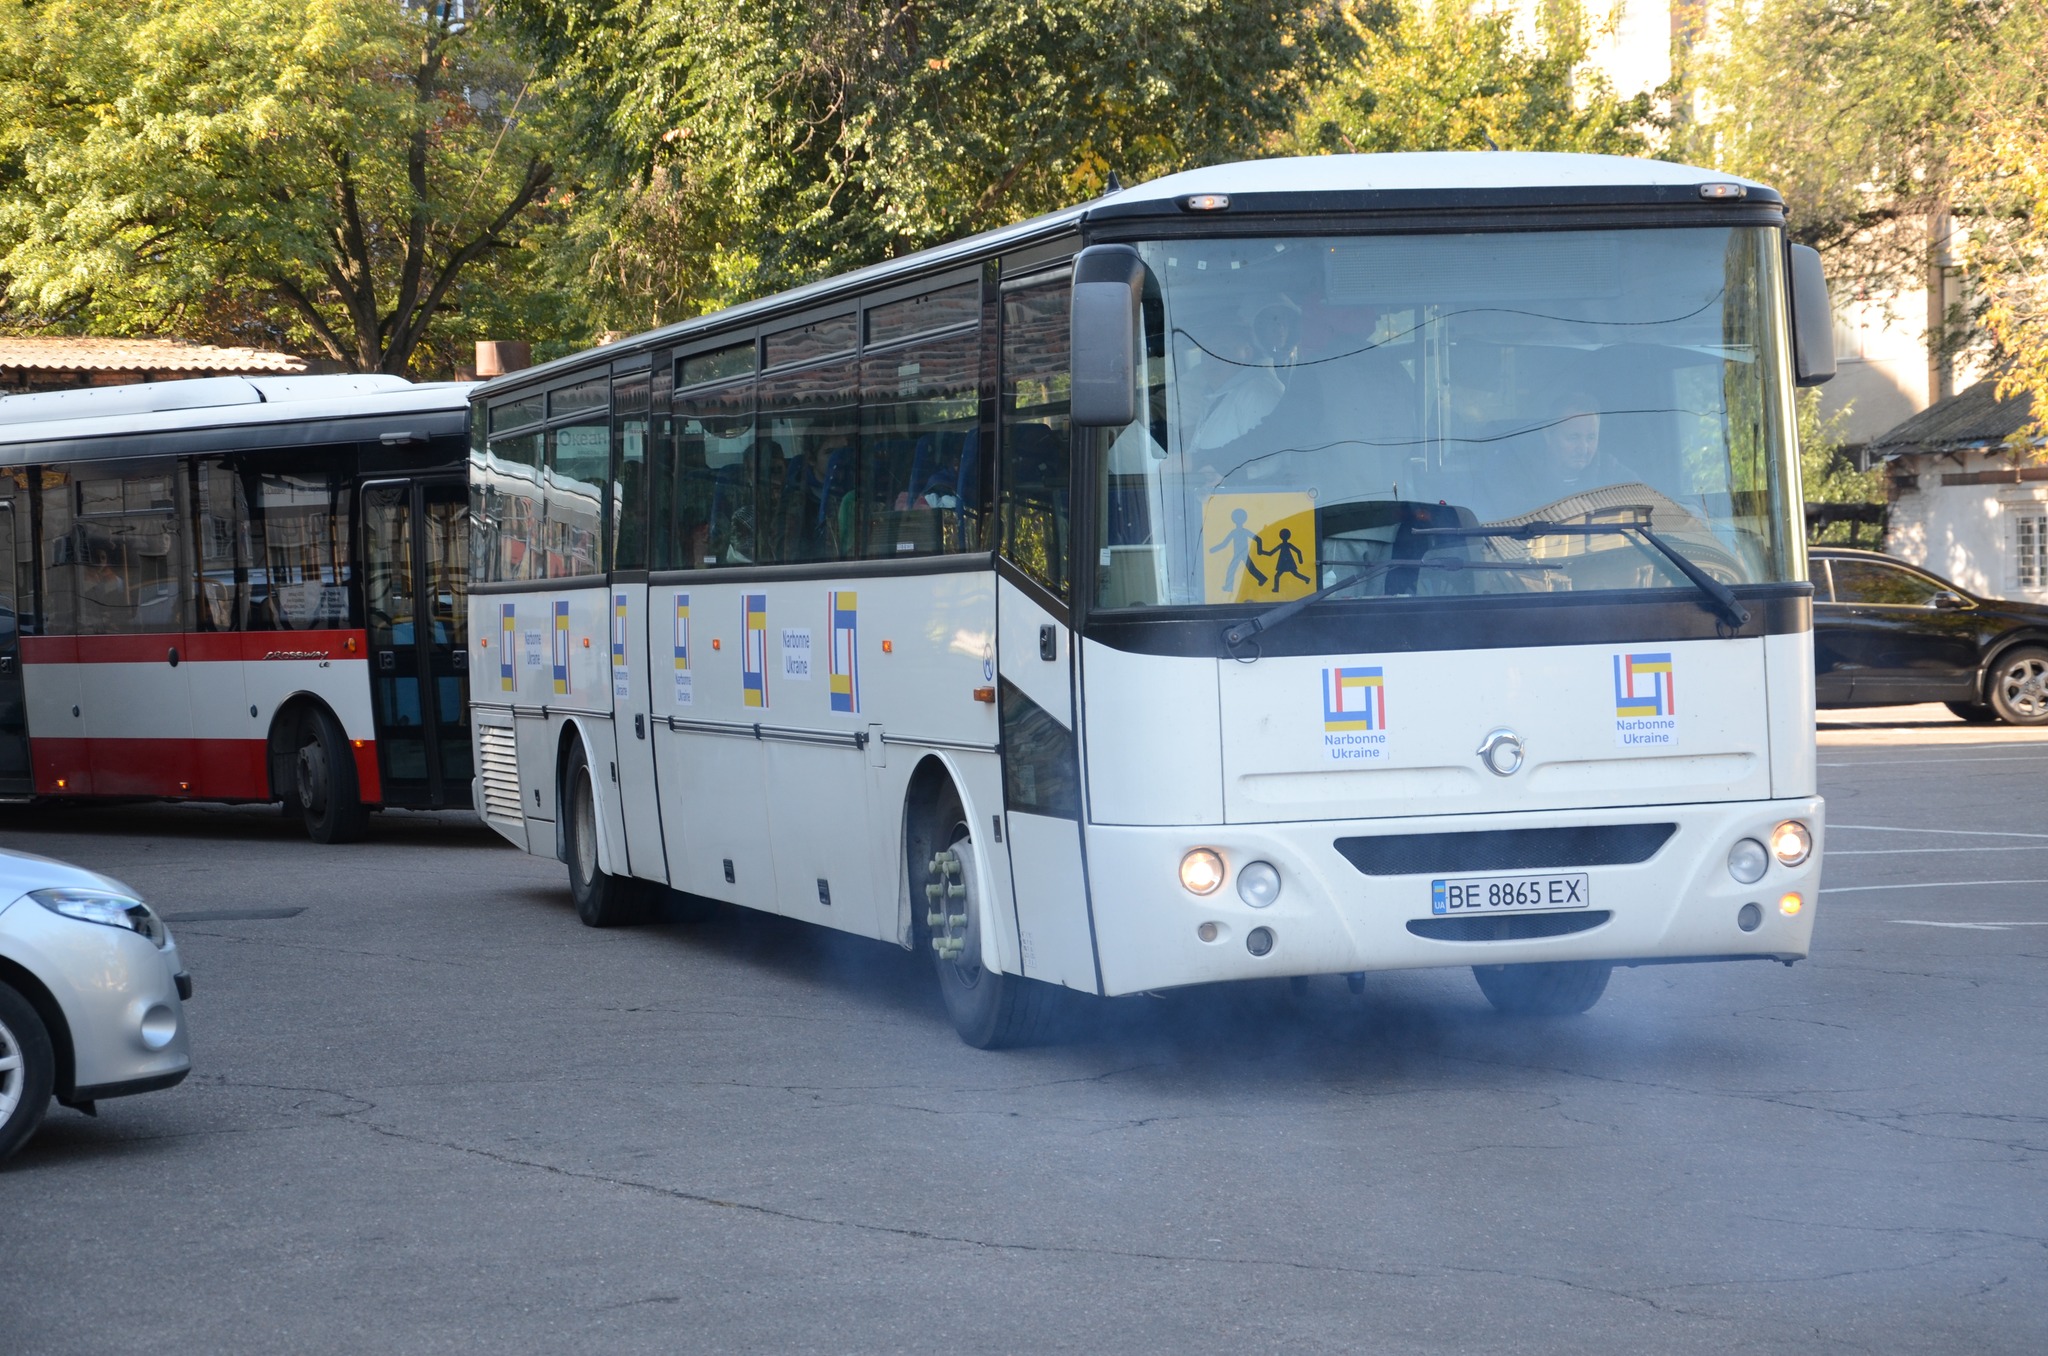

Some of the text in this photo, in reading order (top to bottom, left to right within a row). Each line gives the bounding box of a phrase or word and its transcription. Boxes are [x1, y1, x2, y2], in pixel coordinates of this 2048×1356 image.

[782, 630, 810, 648] Narbonne
[786, 655, 808, 674] Ukraine
[1616, 718, 1675, 731] Narbonne
[1324, 732, 1386, 746] Narbonne
[1623, 731, 1670, 745] Ukraine
[1331, 747, 1381, 759] Ukraine
[1449, 879, 1581, 909] BE 8865 EX
[1434, 900, 1446, 910] UA
